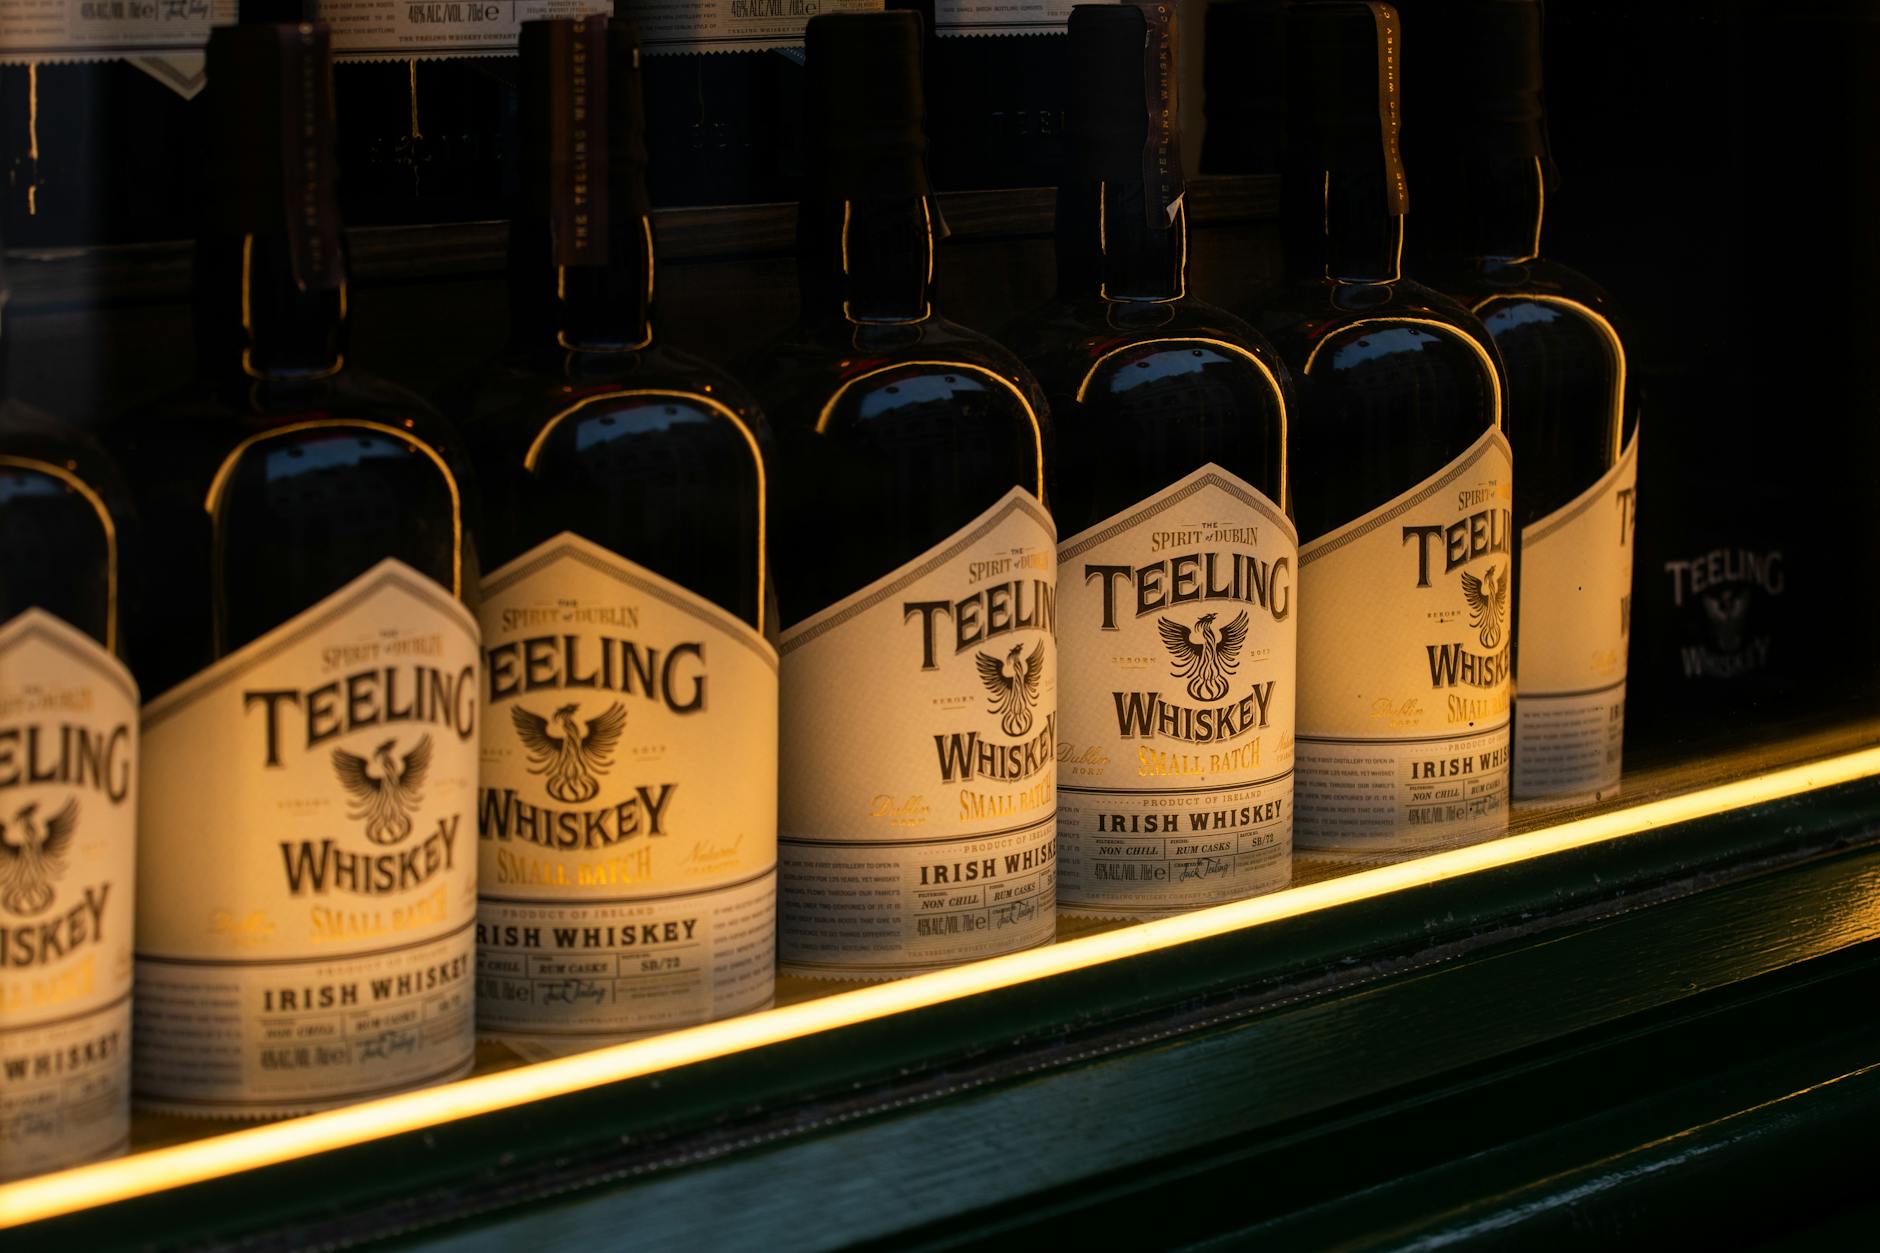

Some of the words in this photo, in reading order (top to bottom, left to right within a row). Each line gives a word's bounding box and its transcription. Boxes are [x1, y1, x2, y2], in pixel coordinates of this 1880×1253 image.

[1160, 32, 1170, 100] WHISKEY
[1010, 548, 1023, 556] THE
[1151, 530, 1202, 552] SPIRIT
[1214, 527, 1258, 547] DUBLIN
[968, 558, 1012, 584] SPIRIT
[1664, 547, 1784, 608] TEELING
[1084, 552, 1290, 632] TEELING
[502, 607, 554, 632] SPIRIT
[574, 606, 640, 629] DUBLIN
[482, 634, 708, 718] EELING
[244, 665, 476, 770] TEELING
[1112, 680, 1276, 745] WHISKEY
[934, 711, 1056, 784] WHISKEY
[1138, 745, 1201, 777] SMALL
[1210, 736, 1262, 774] BATCH
[1412, 756, 1474, 779] IRISH
[960, 789, 1016, 823] SMALL
[1143, 798, 1200, 806] PRODUCT
[1205, 796, 1218, 804] OF
[1223, 790, 1262, 803] IRELAND
[1412, 792, 1432, 802] NON
[1435, 788, 1460, 799] CHILL
[478, 784, 679, 851] WHISKEY
[1098, 814, 1180, 833] IRISH
[1189, 799, 1282, 831] WHISKEY
[281, 814, 460, 897] WHISKEY
[964, 839, 1011, 854] PRODUCT
[1016, 836, 1026, 846] OF
[1099, 846, 1121, 856] NON
[1126, 846, 1158, 856] CHILL
[1176, 846, 1198, 855] RUM
[1202, 842, 1230, 854] CASKS
[498, 846, 568, 886] SMALL
[577, 844, 653, 886] BATCH
[920, 858, 996, 886] IRISH
[921, 900, 945, 910] NON
[948, 894, 979, 907] CHILL
[994, 892, 1012, 902] RUM
[1014, 882, 1036, 896] CASKS
[310, 904, 391, 945] SMALL
[502, 909, 565, 921] PRODUCT
[570, 908, 588, 920] OF
[552, 918, 698, 949] WHISKEY
[264, 984, 360, 1012] IRISH
[368, 952, 470, 1002] WHISKEY
